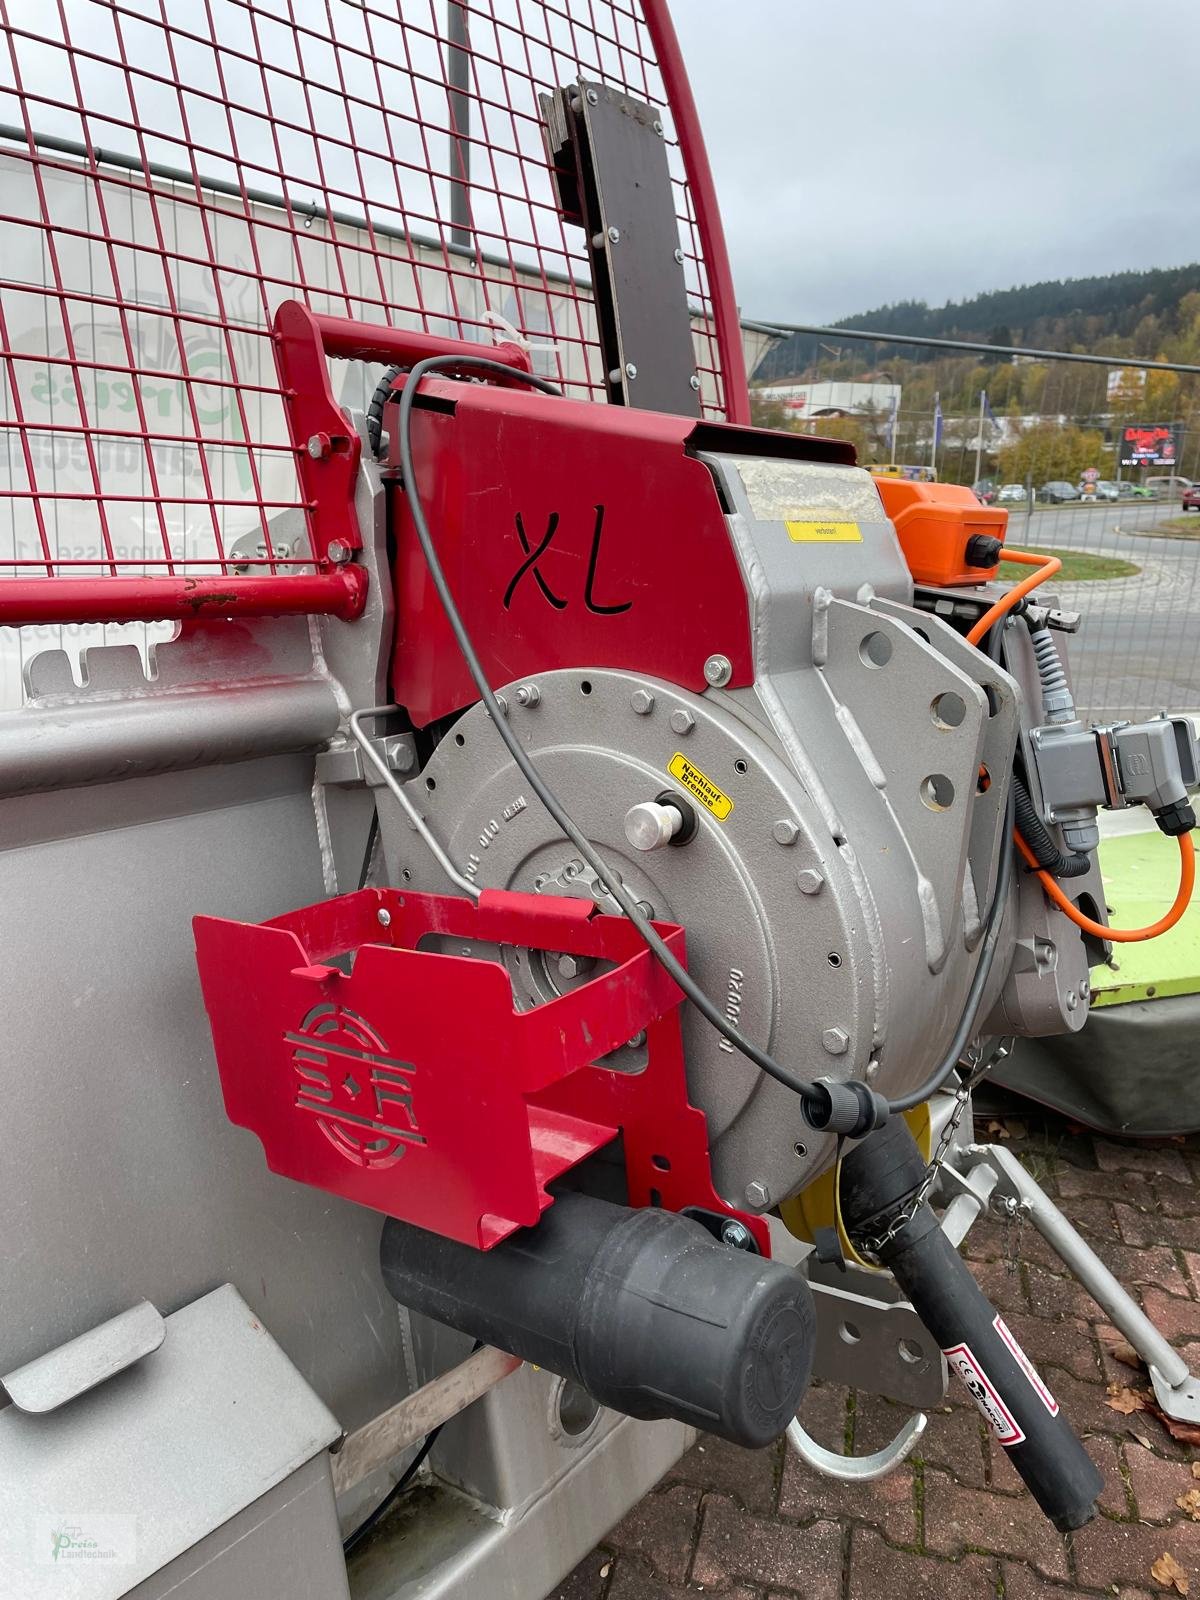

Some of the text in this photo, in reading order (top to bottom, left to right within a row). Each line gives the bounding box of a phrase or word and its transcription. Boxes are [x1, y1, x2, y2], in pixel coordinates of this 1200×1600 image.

[503, 504, 633, 616] XL
[680, 774, 714, 807] Bremse
[681, 762, 722, 804] Nachlauf-
